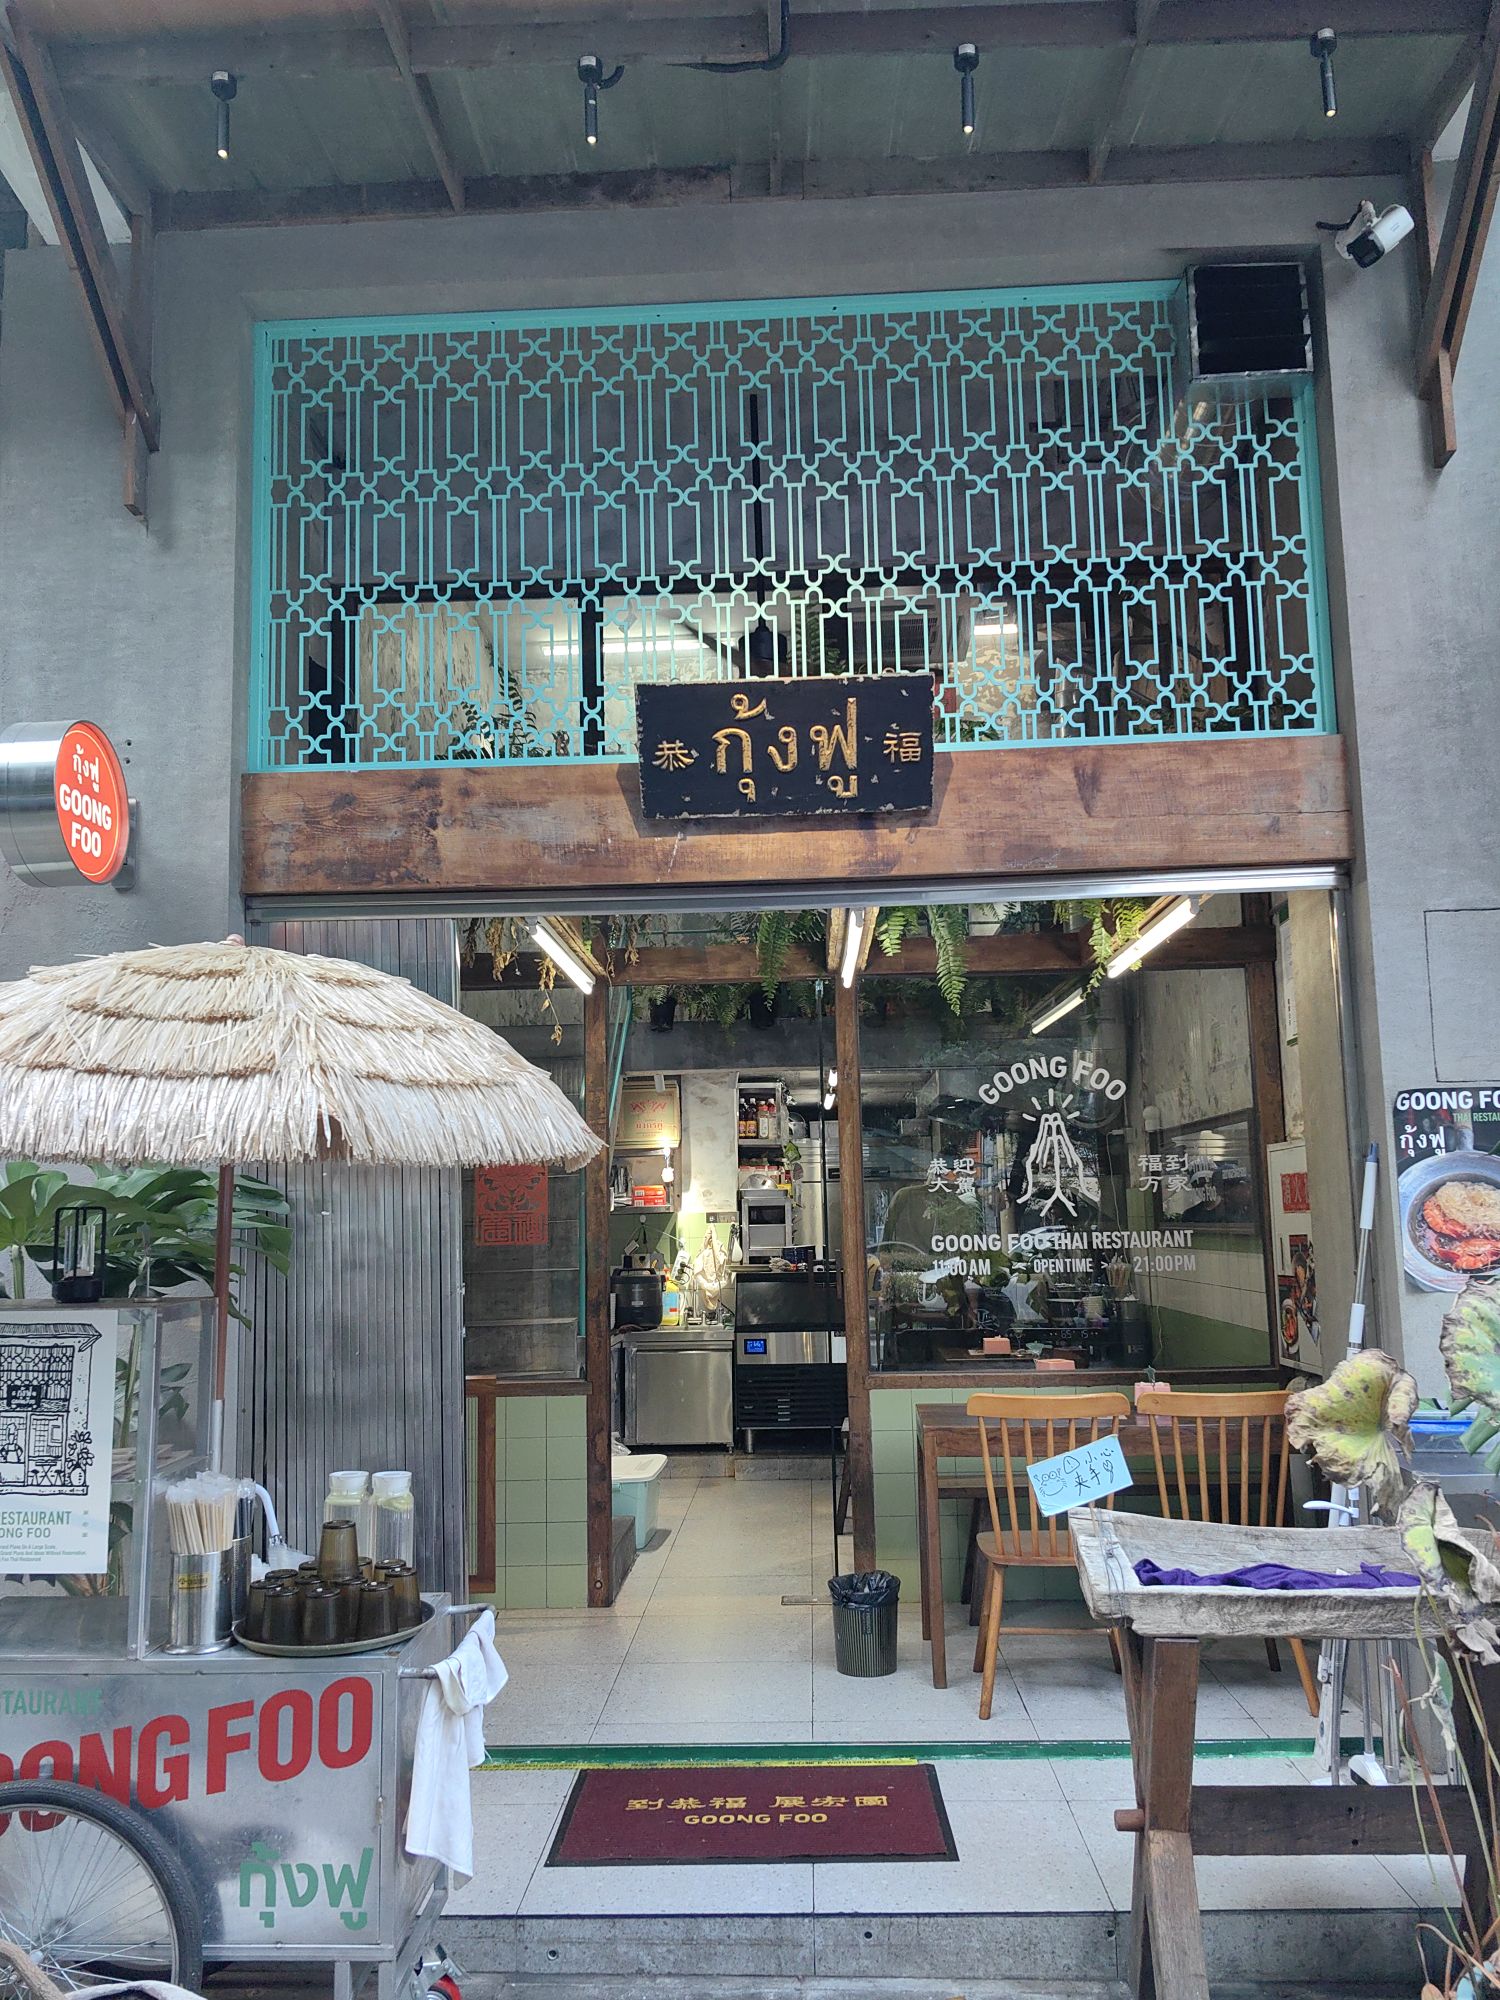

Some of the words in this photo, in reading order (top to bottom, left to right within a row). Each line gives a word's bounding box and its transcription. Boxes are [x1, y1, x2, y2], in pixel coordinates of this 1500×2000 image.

[652, 739, 695, 771] 恭
[711, 693, 858, 802] กุ้งฟู
[883, 731, 922, 763] 福
[72, 743, 100, 793] กุ้งฟู
[59, 783, 112, 831] GOONG
[71, 821, 102, 858] FOO
[978, 1056, 1067, 1105] GOONG
[1072, 1060, 1127, 1101] FOO
[1396, 1091, 1474, 1110] GOONG
[1453, 1113, 1472, 1122] THAI
[1399, 1124, 1446, 1157] กุ้งฟู
[1137, 1154, 1189, 1172] 福到
[931, 1234, 1002, 1252] GOONG
[1054, 1231, 1089, 1250] THAI
[1092, 1230, 1194, 1249] RESTAURANT
[0, 1511, 72, 1525] ESTAURANT
[27, 1528, 51, 1538] FOO
[0, 1714, 190, 1837] ONG
[206, 1676, 374, 1795] FOO
[684, 1814, 771, 1825] GOONG
[778, 1813, 828, 1824] FOO
[239, 1841, 374, 1932] กุ้งฟู
